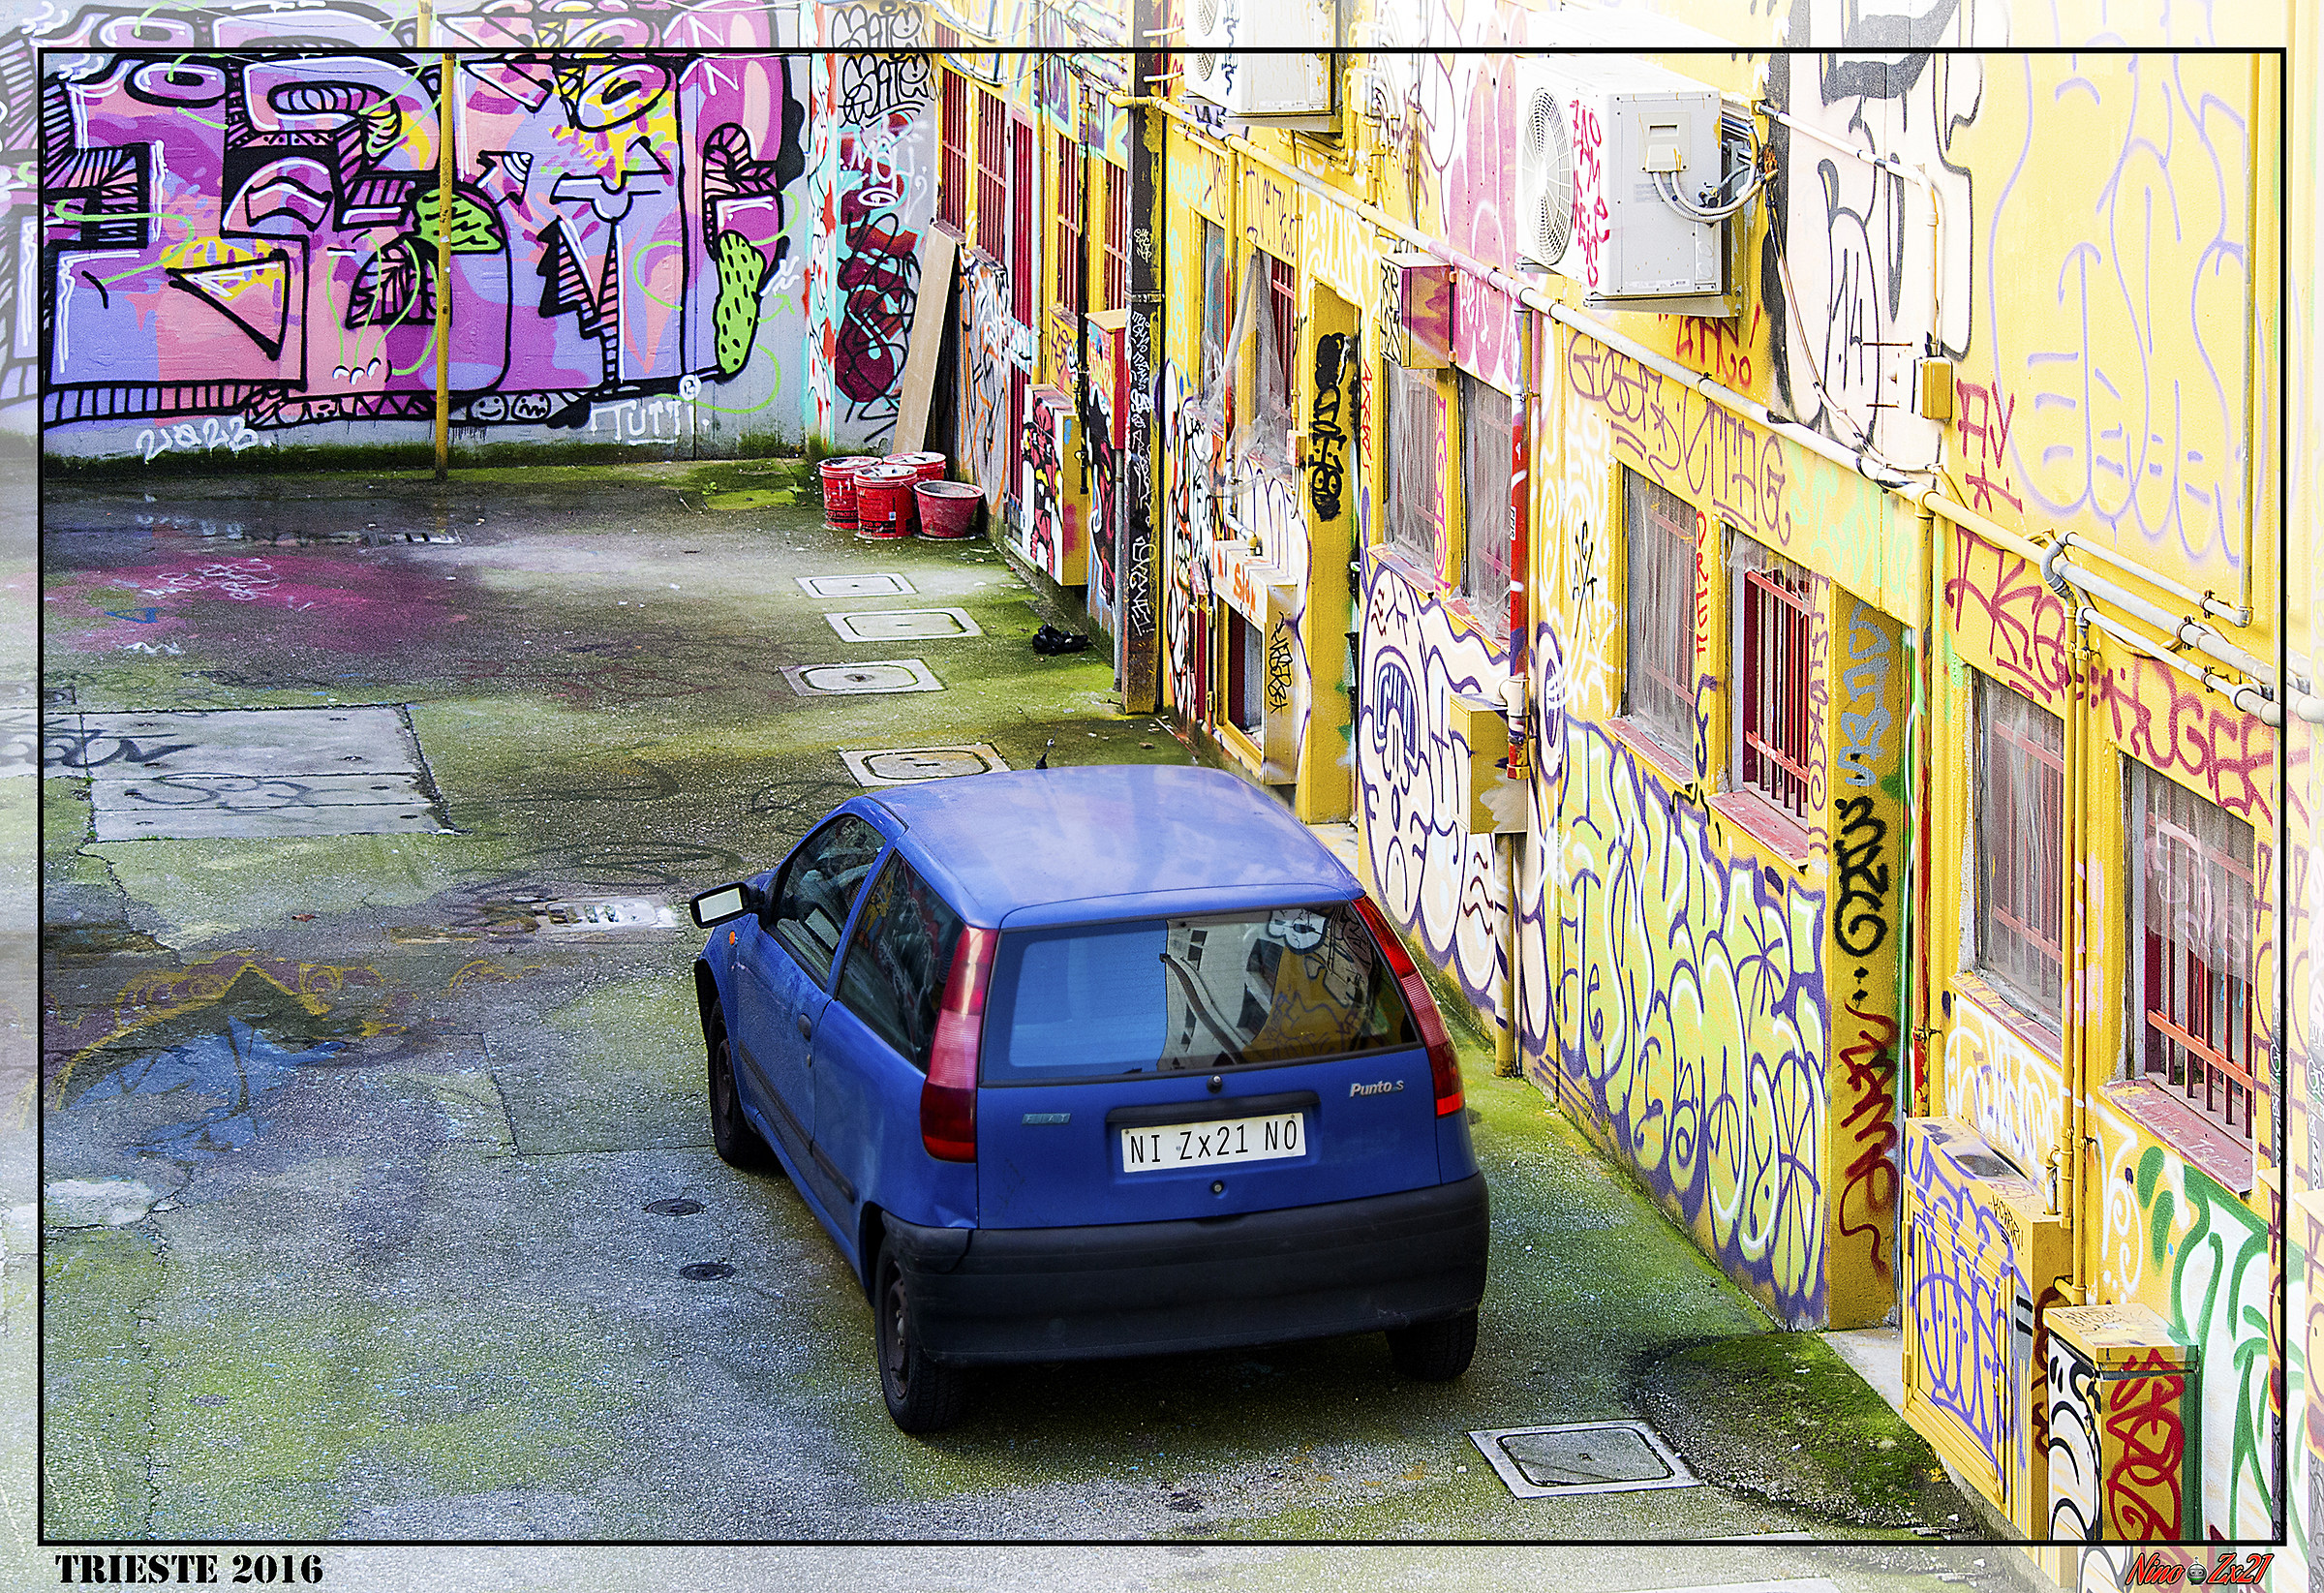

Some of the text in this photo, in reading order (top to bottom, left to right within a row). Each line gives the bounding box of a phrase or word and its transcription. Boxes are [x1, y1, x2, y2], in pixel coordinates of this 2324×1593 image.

[1349, 1081, 1392, 1098] Punto
[1130, 1119, 1298, 1164] NI Zx21 NO
